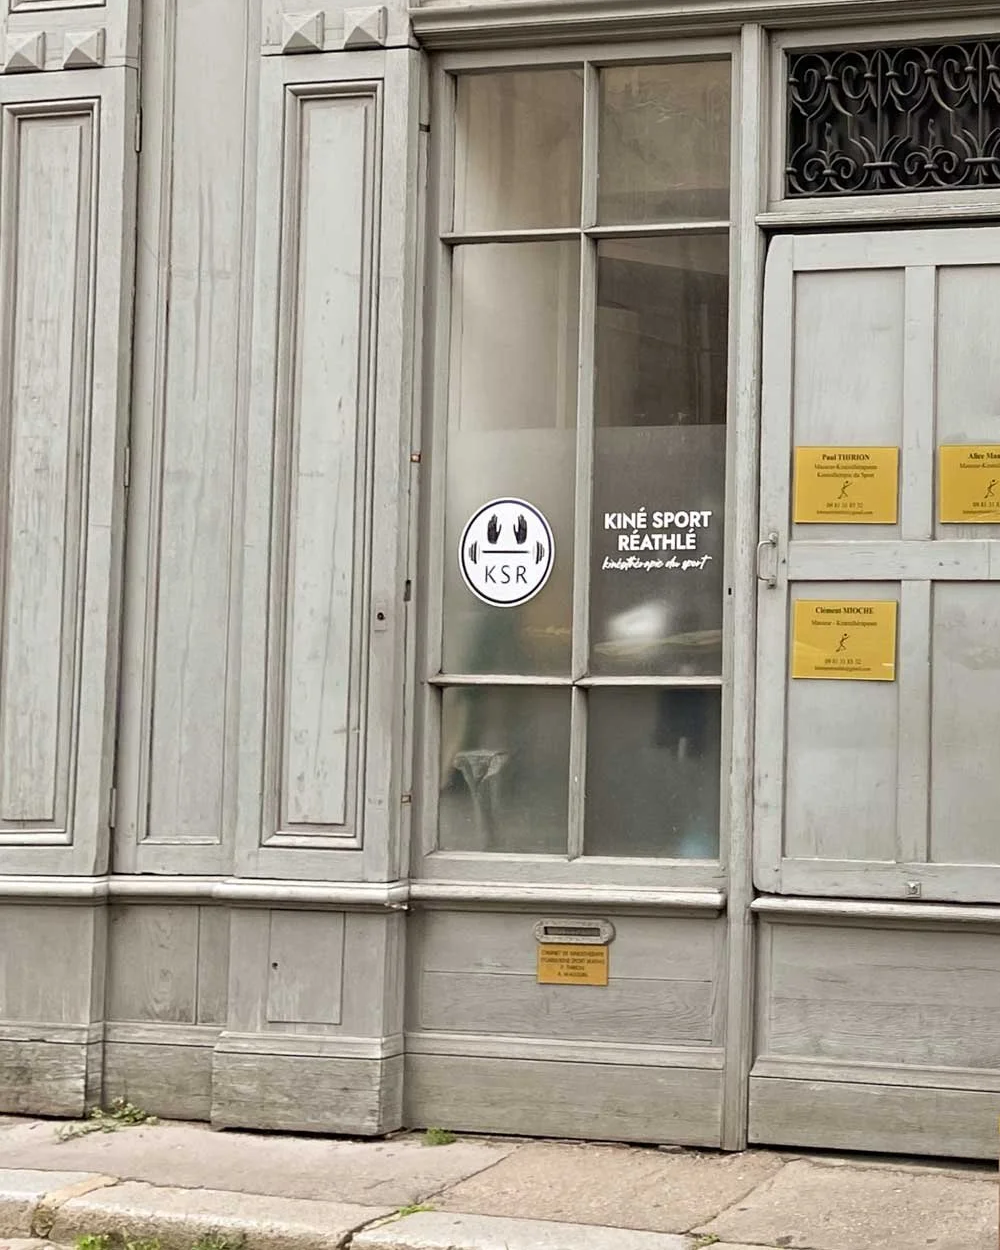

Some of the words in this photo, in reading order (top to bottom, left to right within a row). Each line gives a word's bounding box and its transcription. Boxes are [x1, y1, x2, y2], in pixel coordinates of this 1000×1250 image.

[604, 506, 647, 529] KINÉ
[652, 511, 712, 528] SPORT
[618, 528, 696, 551] RÉATHLÉ
[681, 554, 712, 571] sport
[484, 564, 528, 584] KSR
